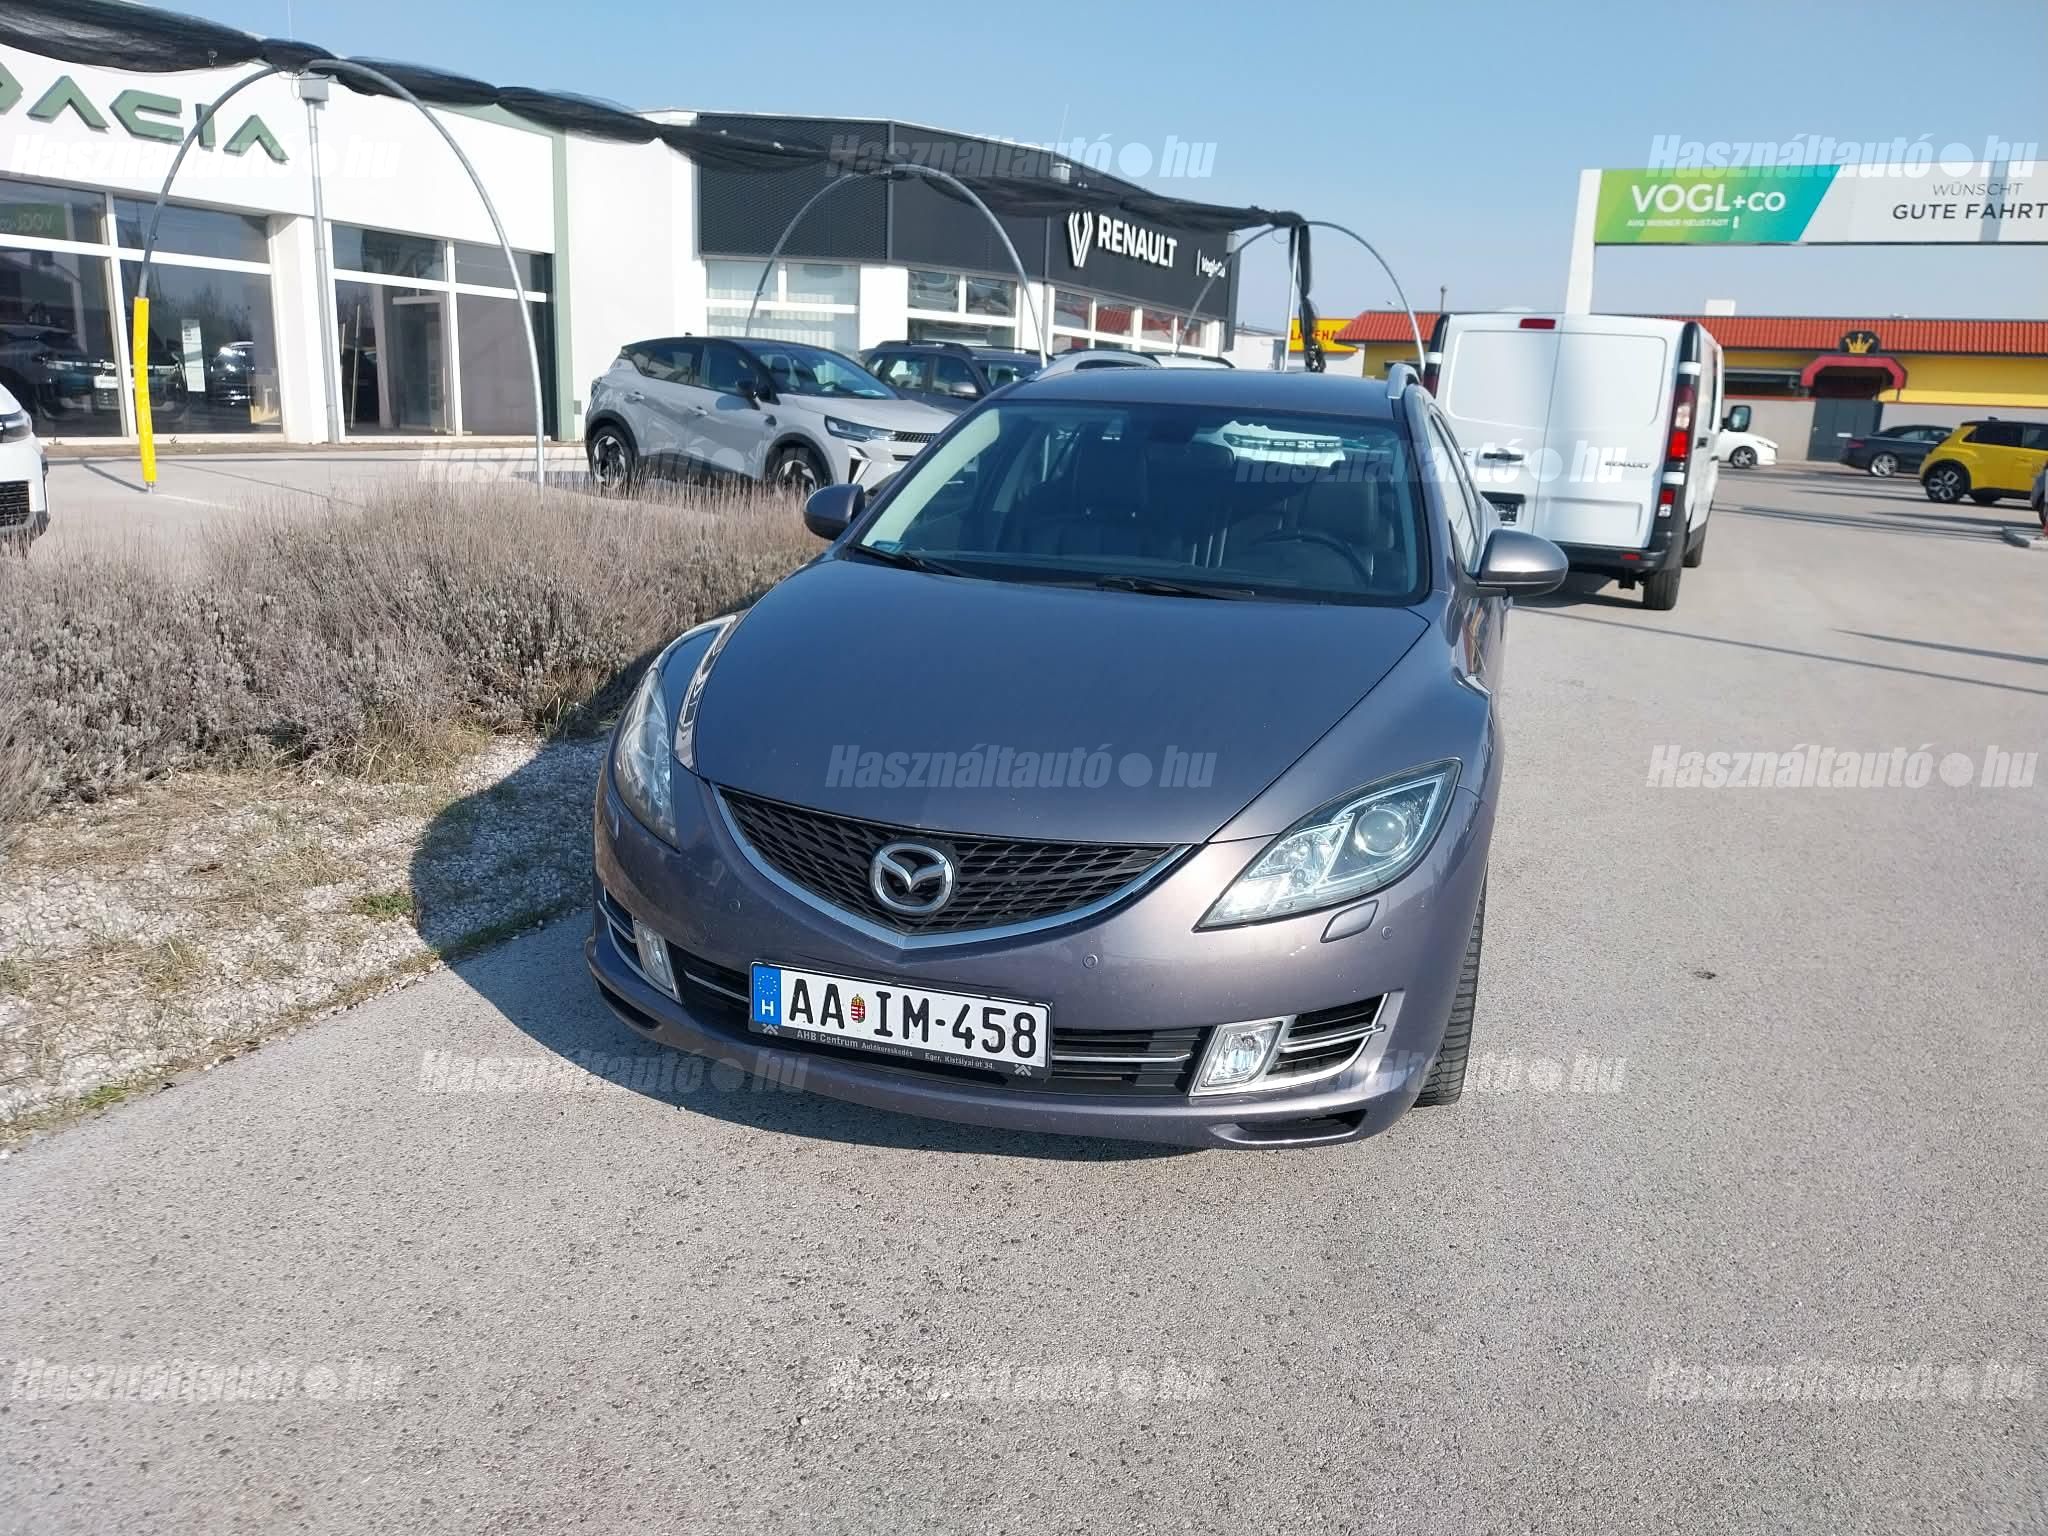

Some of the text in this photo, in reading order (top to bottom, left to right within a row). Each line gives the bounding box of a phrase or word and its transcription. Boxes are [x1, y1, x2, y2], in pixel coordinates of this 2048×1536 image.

[1932, 181, 2024, 197] WÜNSCHT
[1892, 202, 2048, 220] GUTE FAHRT
[1098, 214, 1178, 267] RENAULT
[761, 999, 775, 1017] H
[788, 978, 1037, 1059] AA IM-458
[797, 1029, 817, 1042] AHB
[820, 1033, 859, 1049] Centrum
